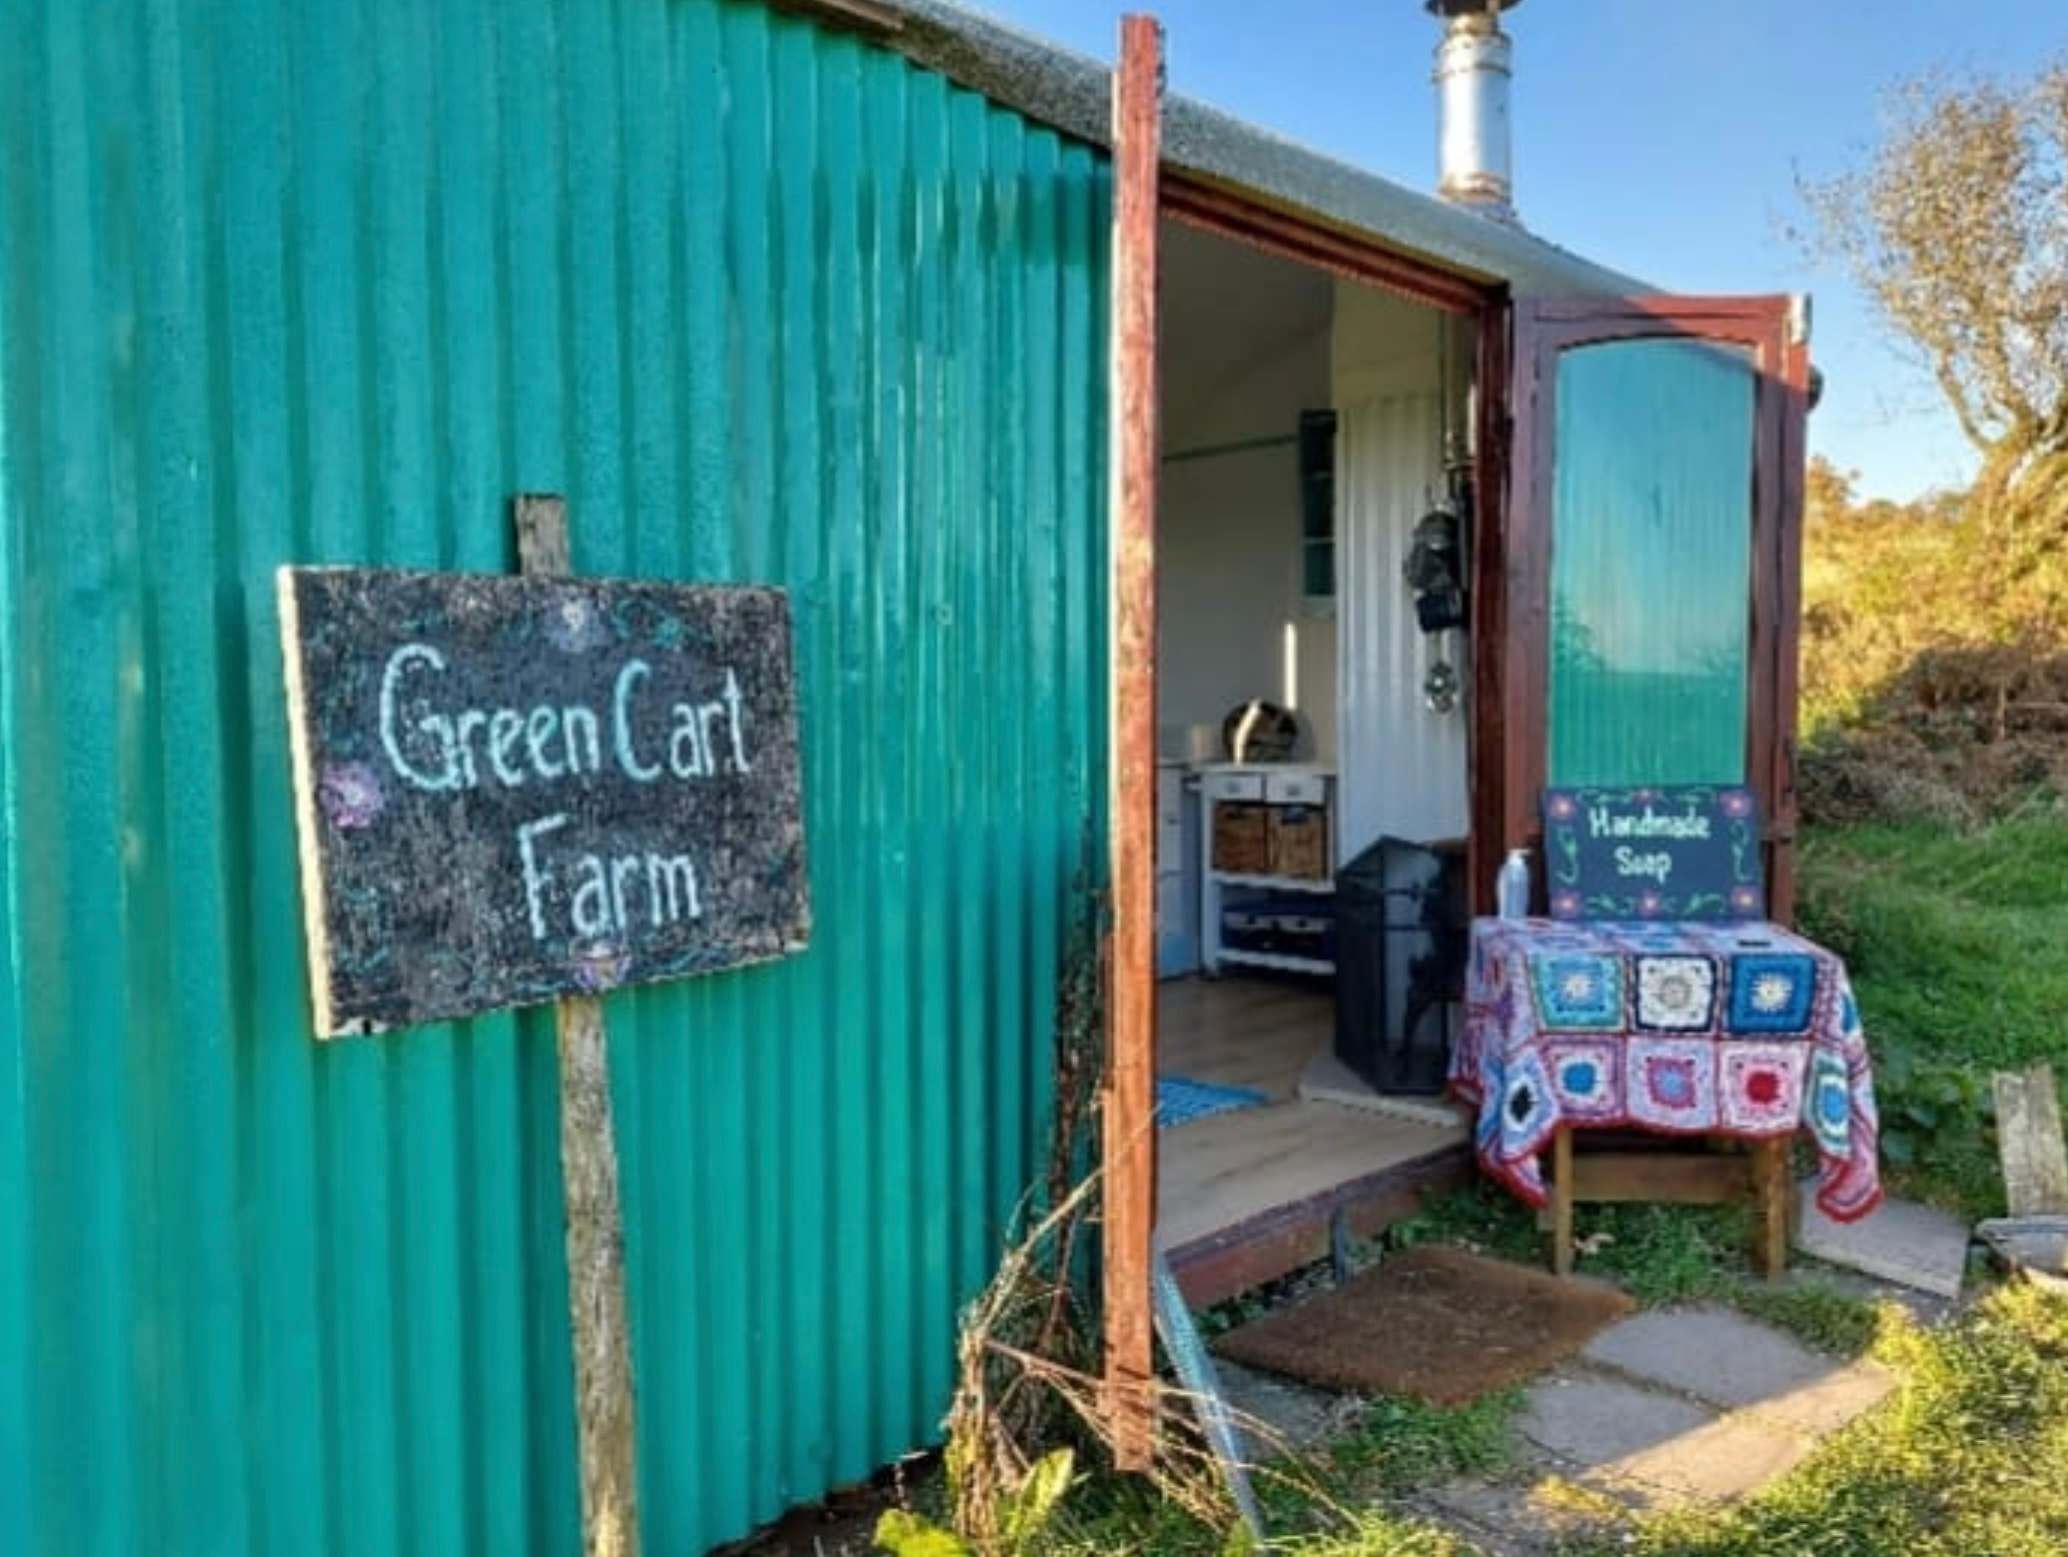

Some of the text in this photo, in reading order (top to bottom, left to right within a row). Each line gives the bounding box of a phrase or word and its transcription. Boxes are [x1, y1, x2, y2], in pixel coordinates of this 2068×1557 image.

[379, 642, 750, 790] Green Cart
[517, 812, 701, 940] Farm
[1588, 806, 1711, 839] Handmade
